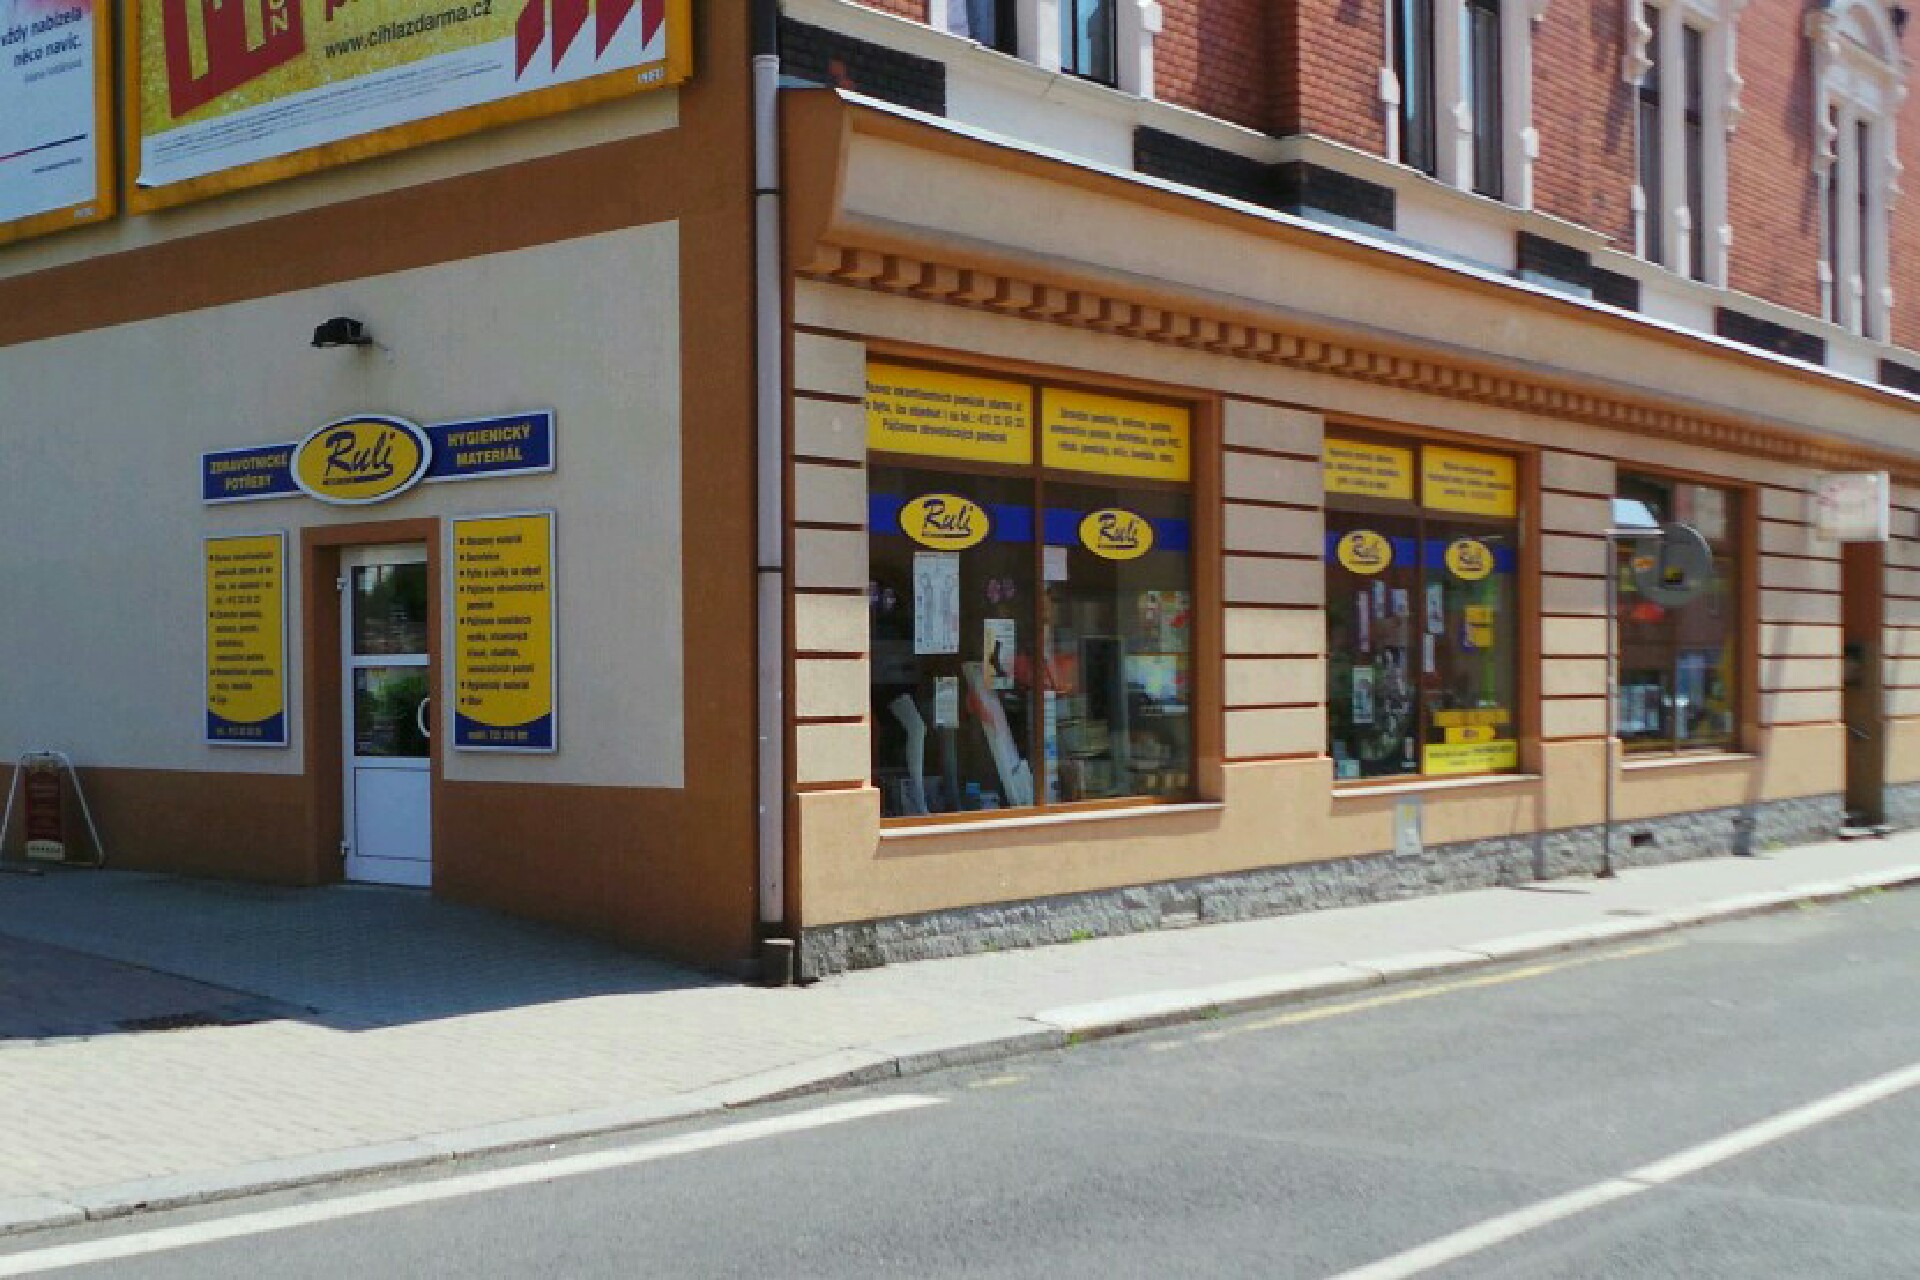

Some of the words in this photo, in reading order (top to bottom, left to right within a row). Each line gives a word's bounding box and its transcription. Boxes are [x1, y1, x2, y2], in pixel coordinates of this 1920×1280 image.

[324, 0, 492, 58] www.cihlazdarma.cz
[447, 422, 531, 448] HYGIENICKÝ
[456, 443, 523, 468] MATERIÁL
